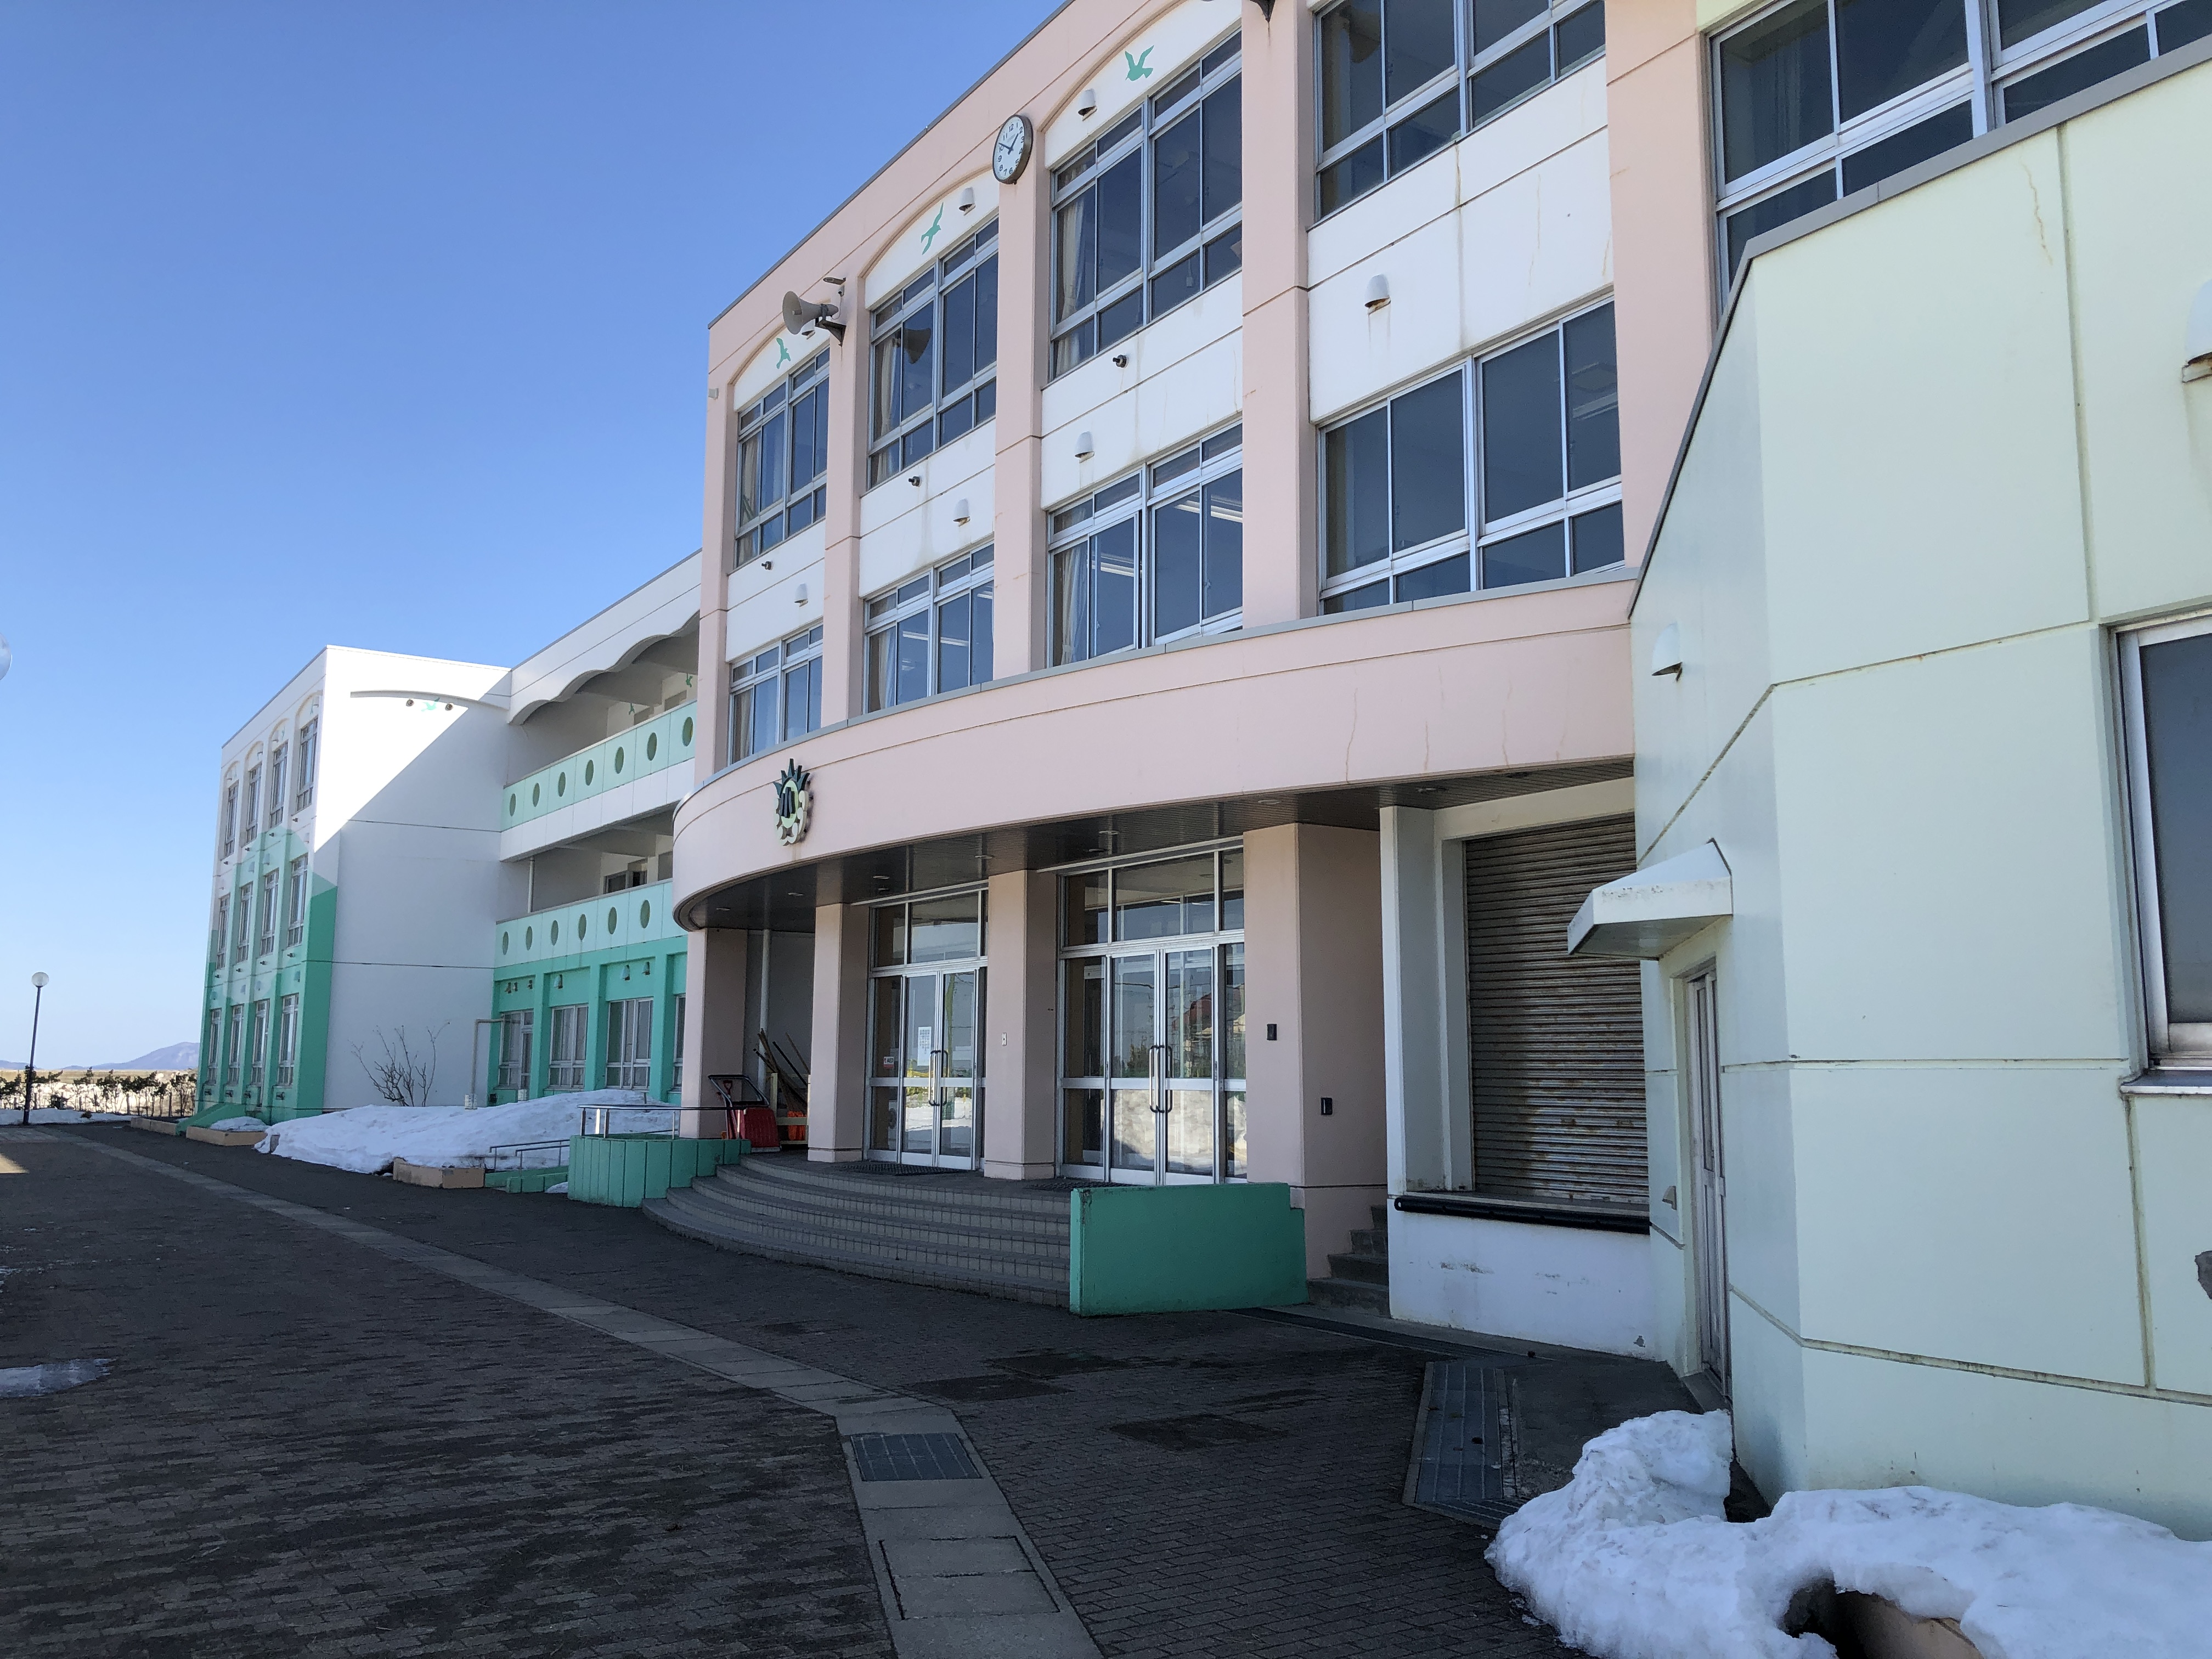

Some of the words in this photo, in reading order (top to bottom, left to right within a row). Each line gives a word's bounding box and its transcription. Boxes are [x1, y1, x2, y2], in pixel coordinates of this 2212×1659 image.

[1009, 124, 1014, 132] 12
[1019, 126, 1023, 134] 2
[1003, 133, 1007, 141] 11
